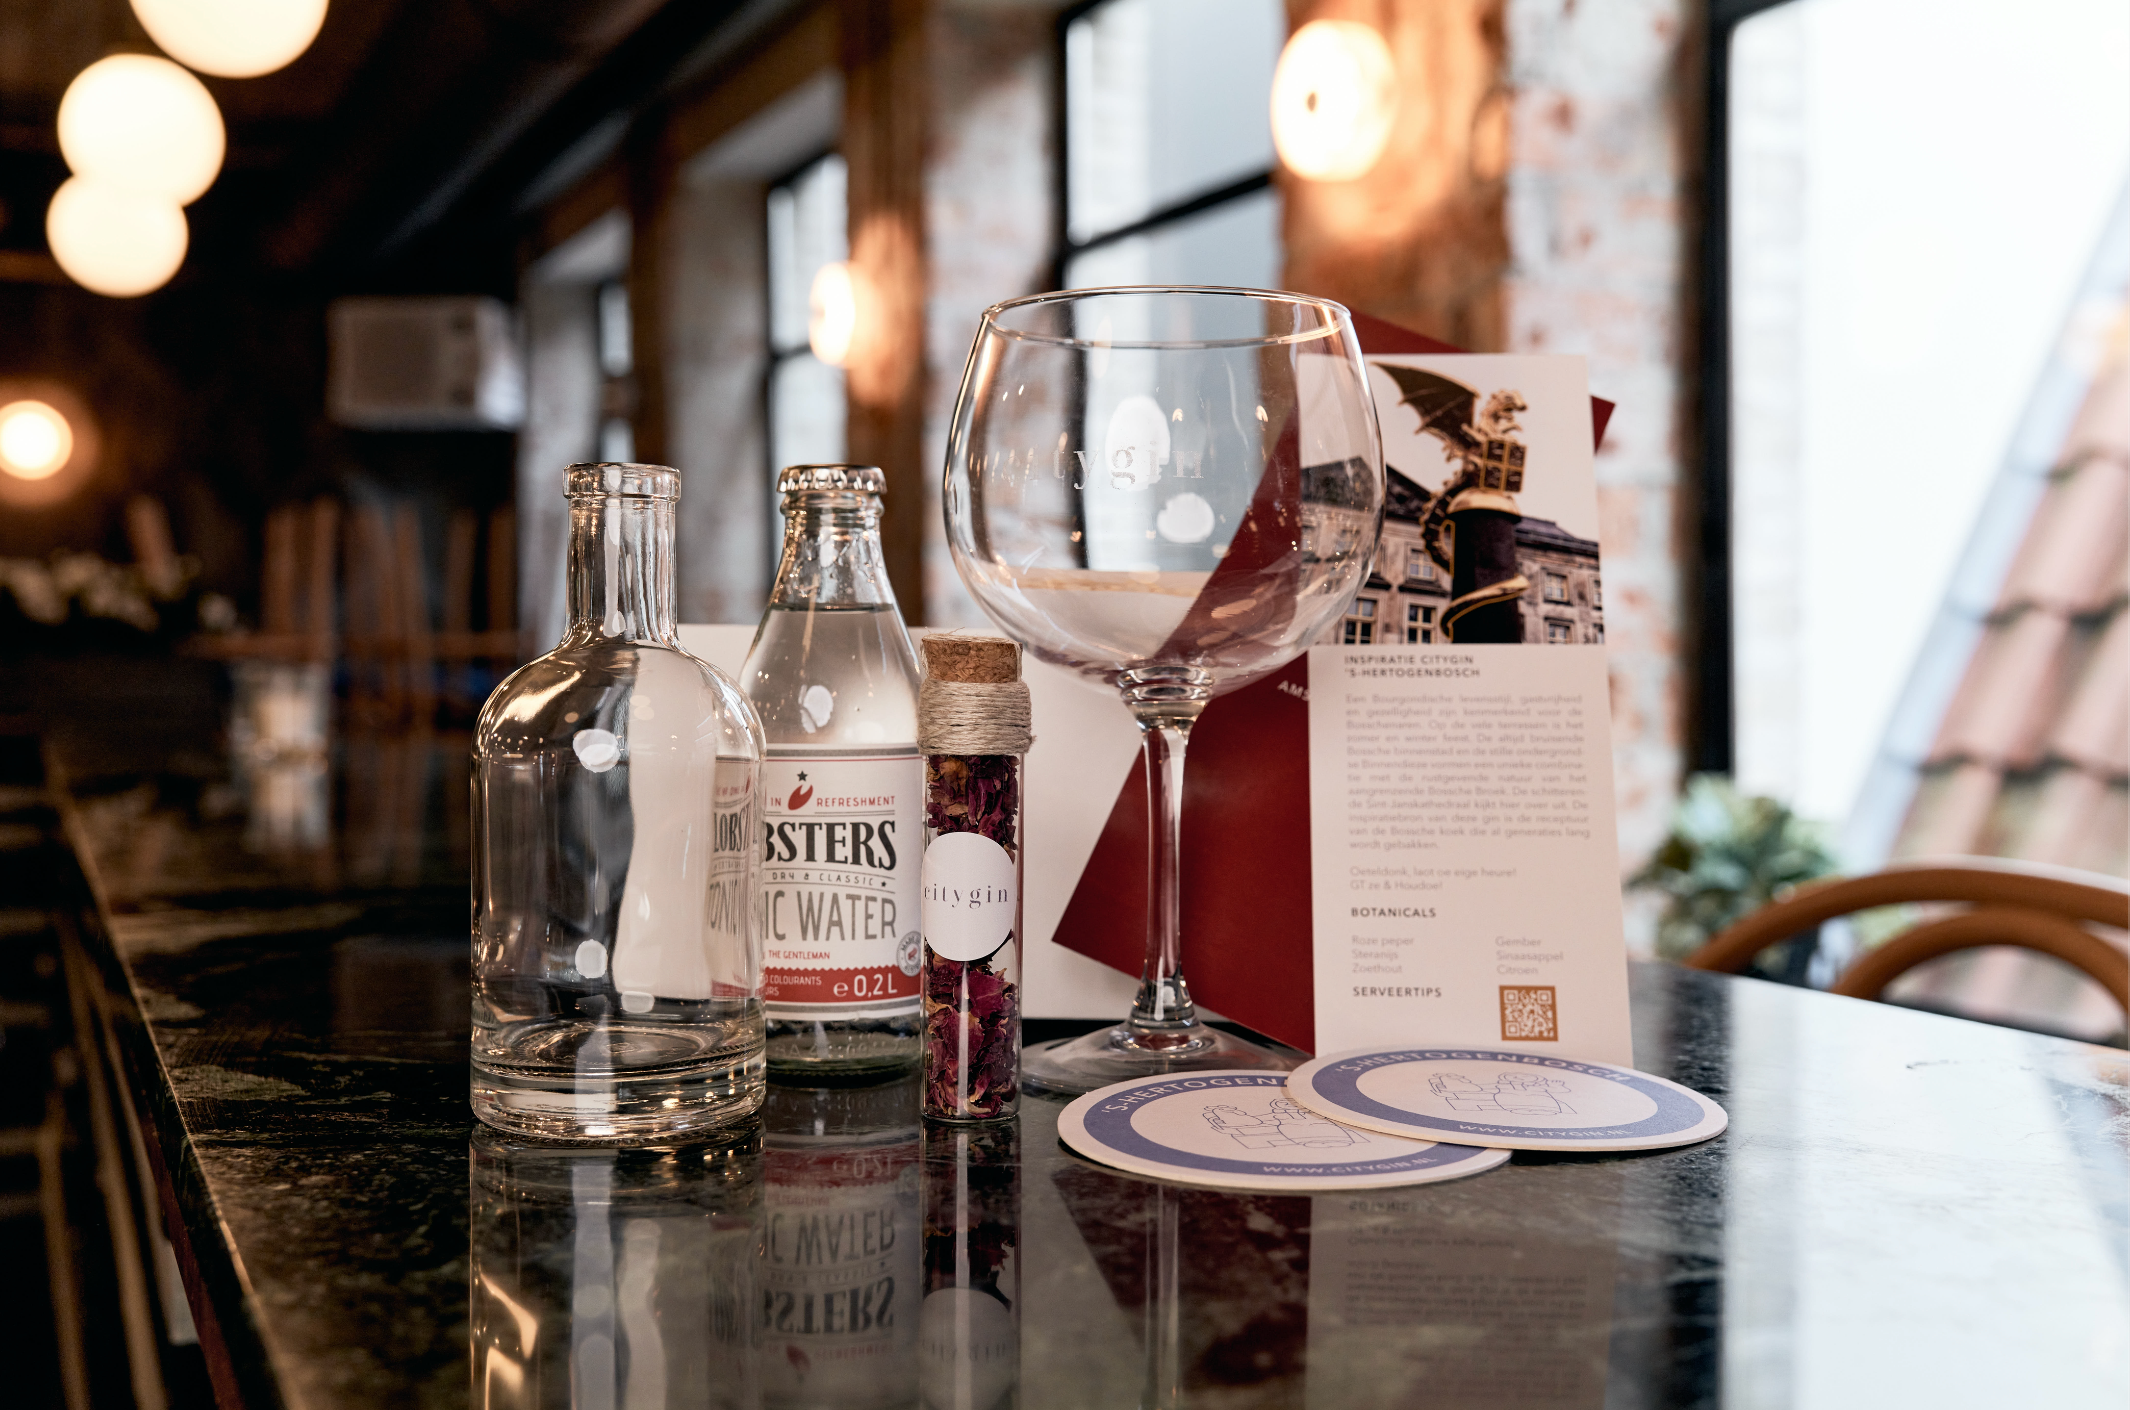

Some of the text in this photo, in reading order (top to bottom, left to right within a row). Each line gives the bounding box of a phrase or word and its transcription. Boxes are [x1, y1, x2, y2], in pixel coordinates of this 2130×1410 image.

[1345, 655, 1474, 665] INSPIRATIE CITYGIN
[1277, 680, 1309, 701] AMS
[770, 797, 782, 807] IN
[816, 796, 896, 807] REFRESHMENT
[772, 872, 796, 881] DRY
[819, 873, 874, 886] CLASSIC
[923, 883, 1009, 909] citygin
[797, 890, 897, 942] WATER
[1351, 907, 1437, 918] BOTANICALS
[1495, 936, 1542, 947] Gember
[768, 950, 831, 960] THE GENTLEMAN
[1496, 950, 1564, 963] Sinaasappel
[769, 974, 822, 986] COLOURANTS
[1353, 986, 1442, 998] SERVEERTIPS
[1335, 1050, 1631, 1082] 'S-HERTOGENBOSCH
[1101, 1077, 1287, 1113] 'S-HERTOGEN
[1263, 1157, 1438, 1174] WWW.CITYGIN.NL
